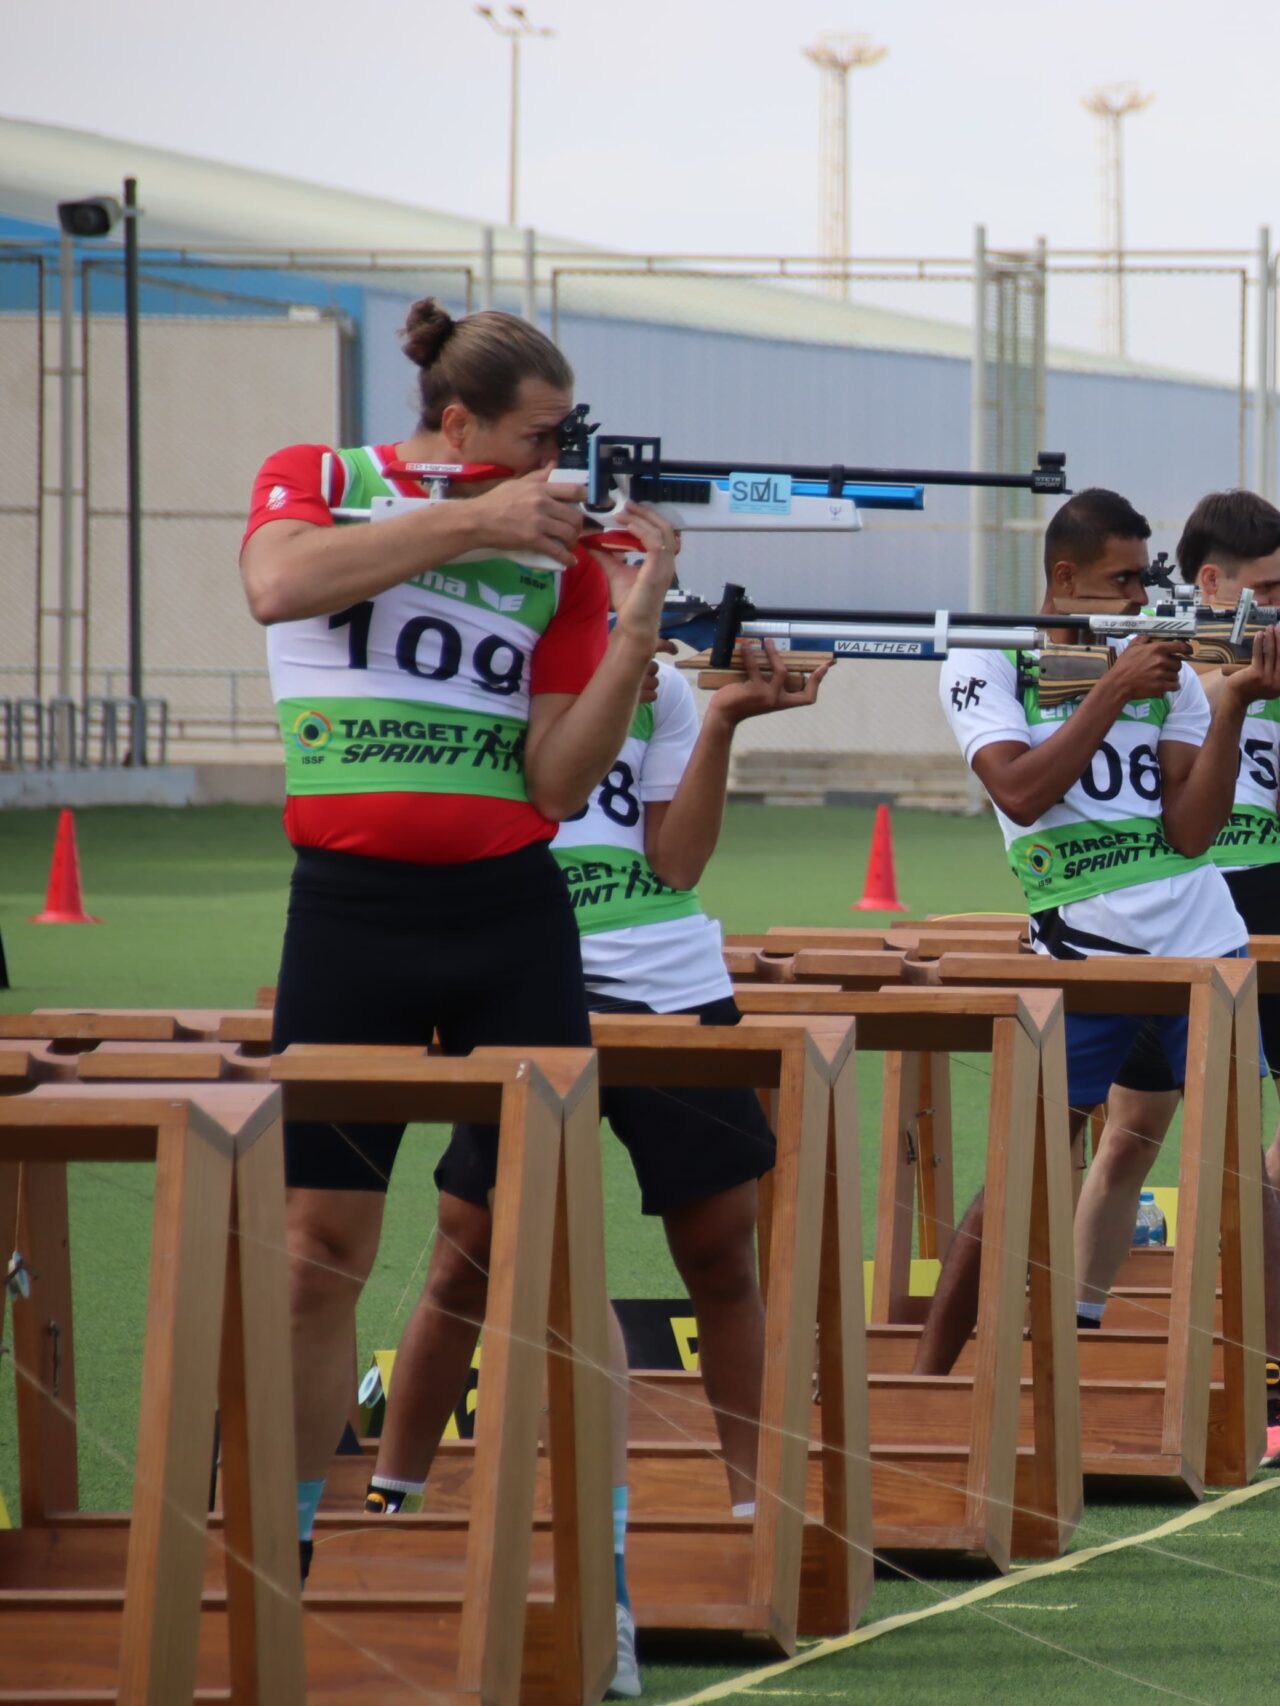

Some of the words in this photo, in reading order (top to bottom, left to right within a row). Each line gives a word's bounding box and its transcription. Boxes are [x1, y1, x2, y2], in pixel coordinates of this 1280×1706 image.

[328, 600, 525, 696] 109
[837, 642, 919, 653] WALTHER
[339, 719, 468, 743] TARGET
[302, 756, 325, 765] ISSF
[341, 743, 468, 765] SPRINT
[1055, 831, 1141, 860] TARGET
[1063, 846, 1146, 880] SPRINT
